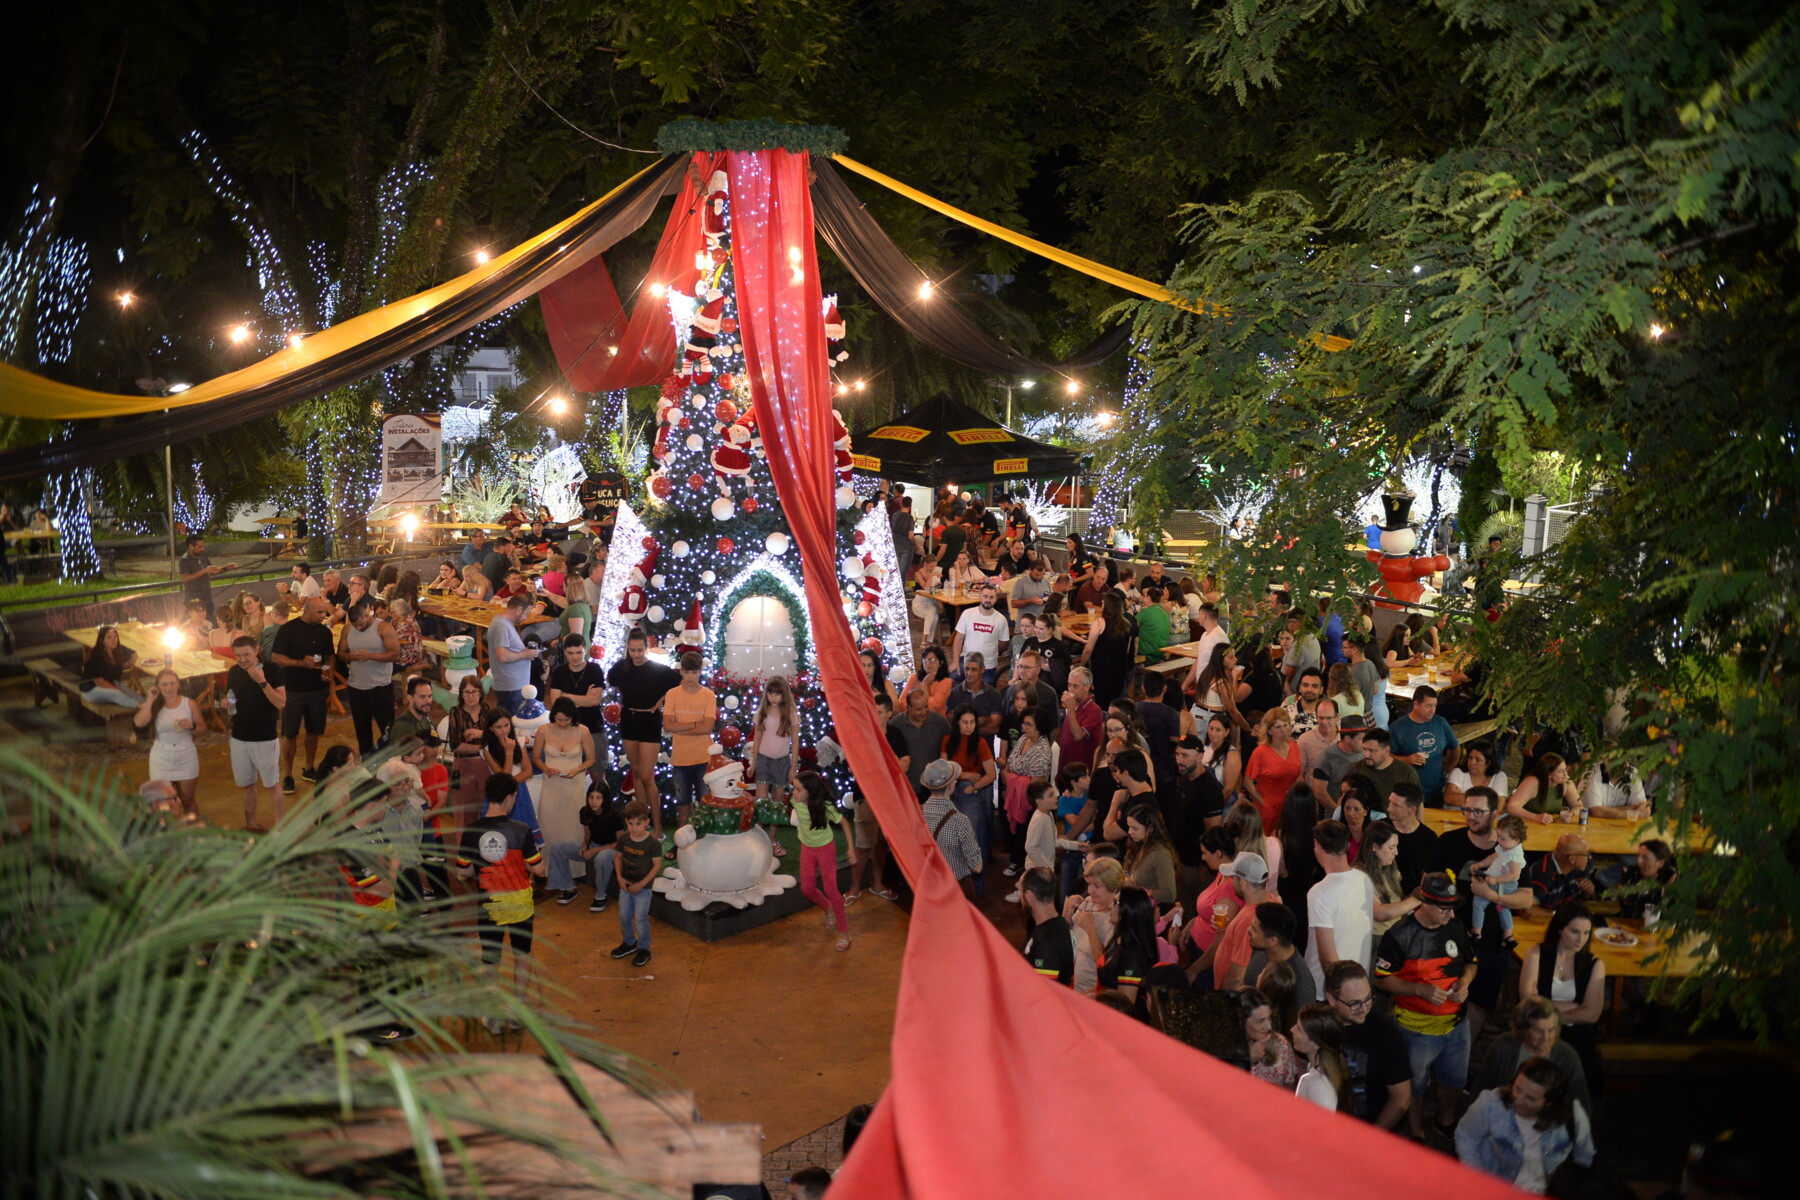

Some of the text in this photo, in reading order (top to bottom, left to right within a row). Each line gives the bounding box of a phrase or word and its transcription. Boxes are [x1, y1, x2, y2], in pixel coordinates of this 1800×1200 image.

[388, 428, 430, 436] INSTALAÇÕES
[955, 430, 1007, 442] PIRELLI
[996, 460, 1025, 472] PIRELLI
[592, 488, 622, 498] UCA E
